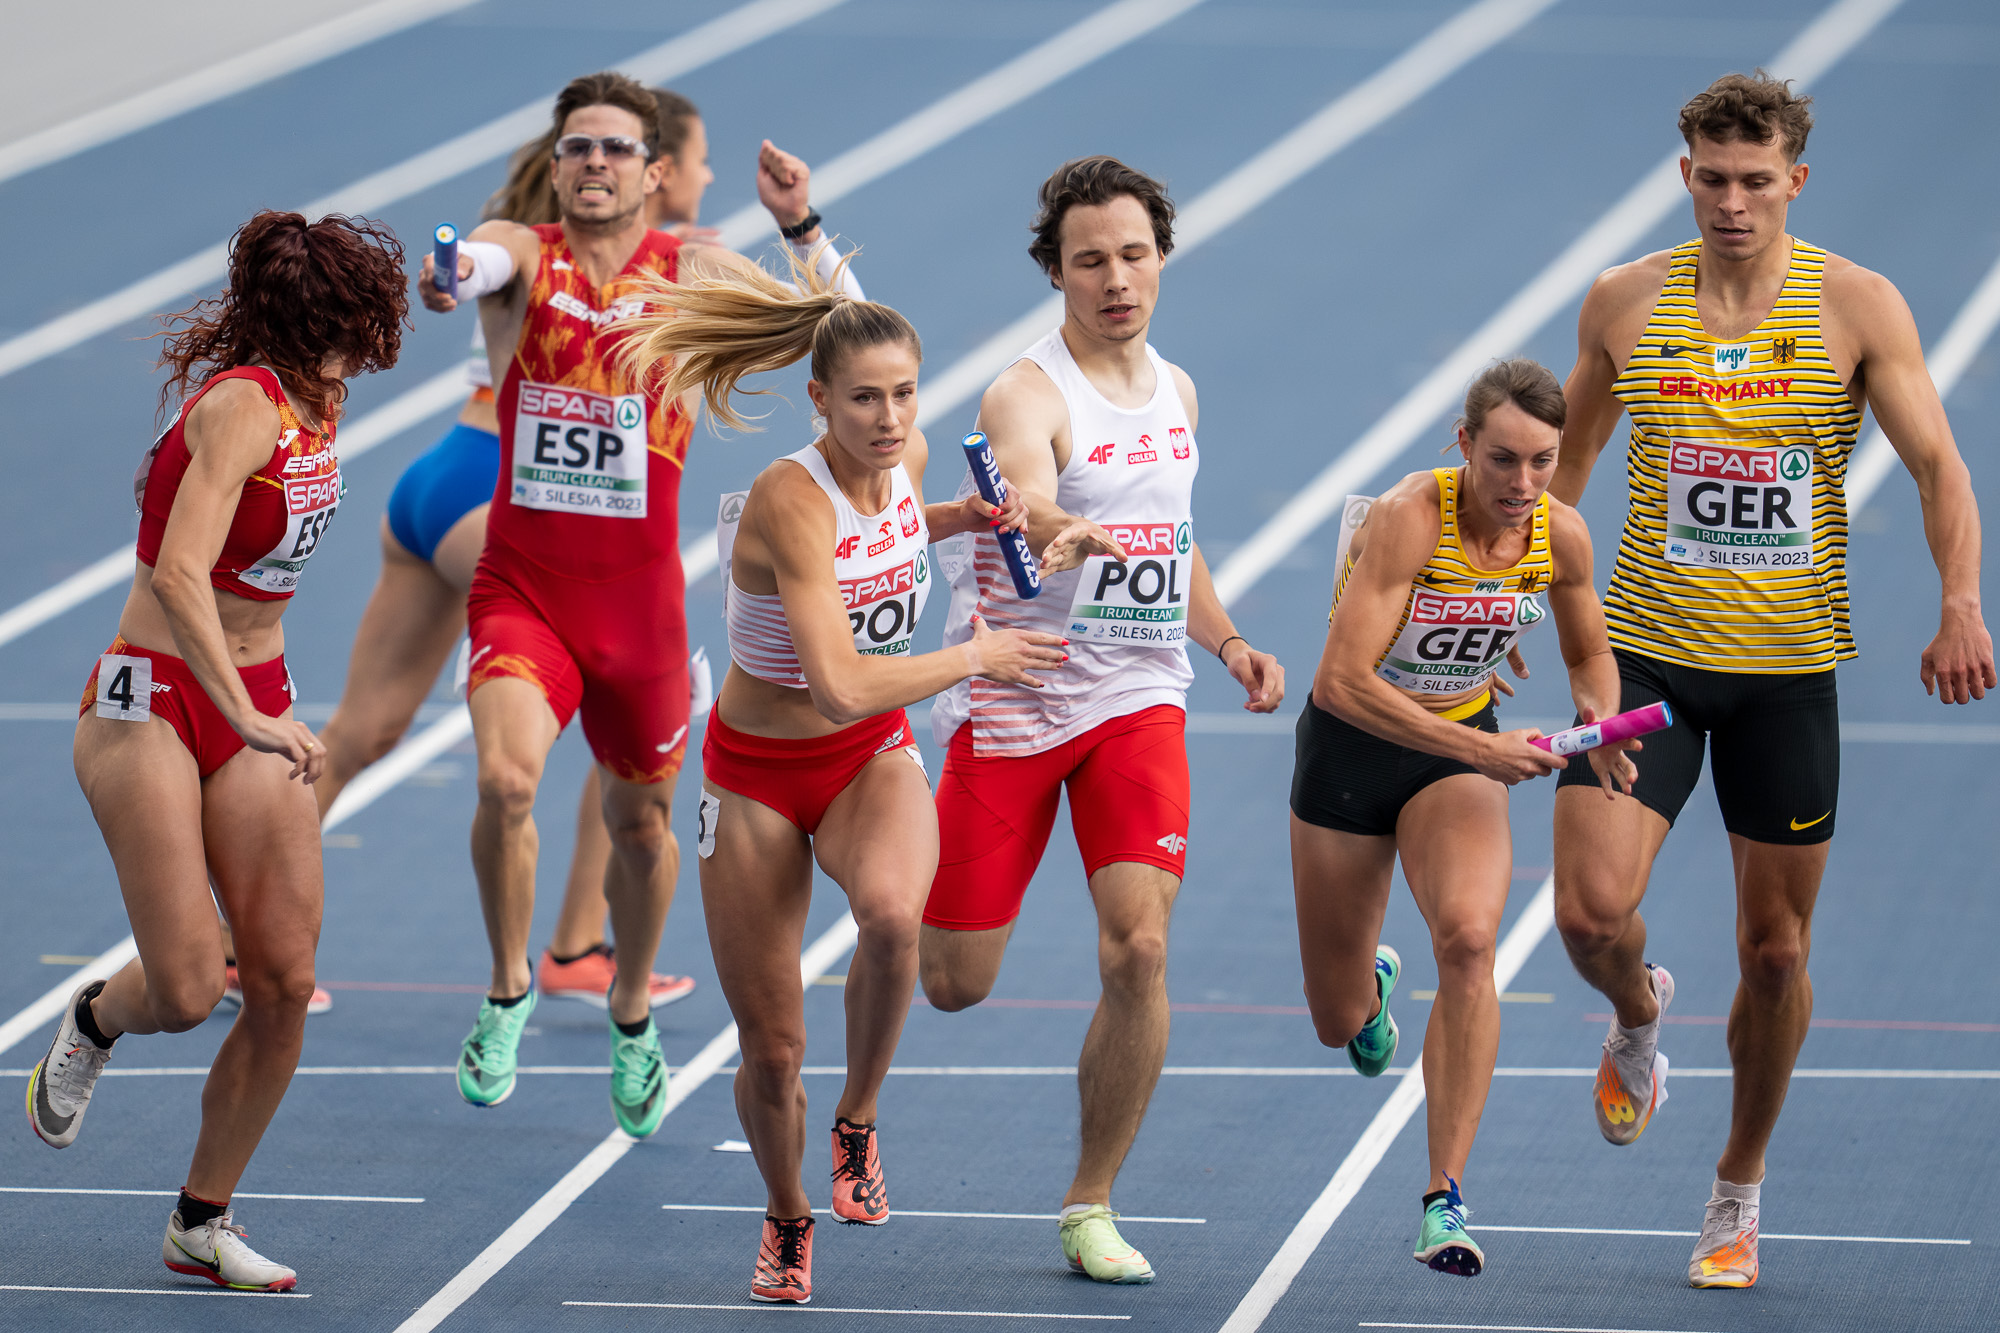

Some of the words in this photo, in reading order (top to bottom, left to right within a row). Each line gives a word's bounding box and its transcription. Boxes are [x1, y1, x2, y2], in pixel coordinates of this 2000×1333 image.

[1659, 376, 1795, 403] GERMANY
[519, 388, 613, 425] SPAR
[282, 441, 336, 474] ESPAÑ
[533, 422, 625, 472] ESP
[1088, 443, 1116, 465] 4F
[1129, 451, 1157, 463] ORLEN
[1673, 447, 1776, 479] SPAR
[540, 471, 569, 484] RUN
[289, 477, 339, 510] SPAR
[545, 489, 602, 507] SILESIA
[606, 496, 642, 511] 2023
[1686, 481, 1798, 530] GER
[290, 507, 336, 559] ESP
[1103, 527, 1172, 551] PAR
[1696, 529, 1700, 540] I
[1702, 530, 1731, 544] RUN
[868, 538, 895, 556] ORLEN
[1709, 550, 1768, 565] SILESIA
[1771, 552, 1809, 566] 2023
[839, 565, 912, 606] SPAR
[1093, 559, 1182, 605] POL
[1106, 607, 1134, 619] RUN
[1416, 597, 1514, 623] SPAR
[1109, 625, 1163, 641] SILESIA
[1166, 626, 1185, 641] 2023
[1416, 626, 1517, 664] GER
[1421, 664, 1451, 674] RUN
[107, 665, 135, 711] 4
[150, 681, 172, 694] SP
[1421, 679, 1474, 692] SILESIA
[1156, 832, 1187, 856] 4F
